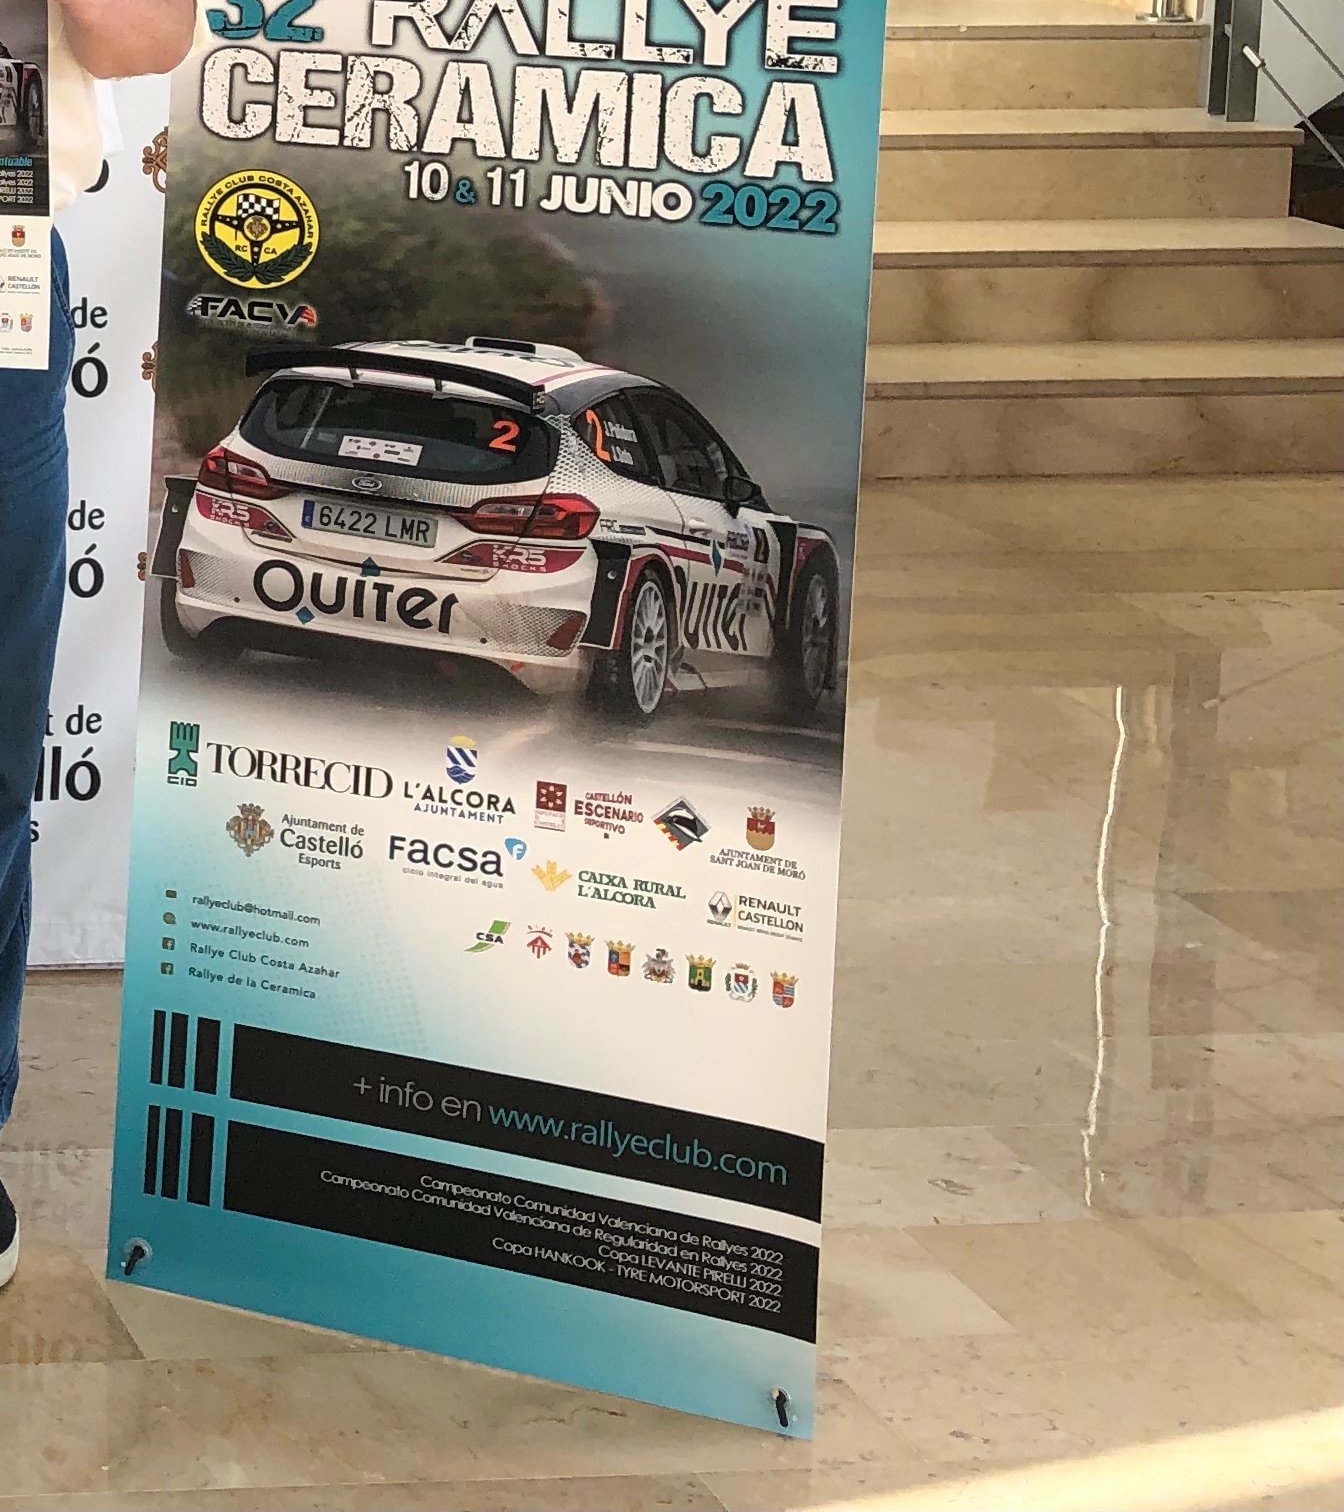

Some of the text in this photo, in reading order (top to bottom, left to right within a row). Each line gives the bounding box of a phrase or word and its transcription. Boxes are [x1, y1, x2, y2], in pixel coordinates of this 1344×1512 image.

[201, 47, 835, 183] CERAMICA
[200, 174, 315, 240] RALLYE CLUB COSTA AZAHAR
[403, 159, 838, 236] 10 & 11 JUNIO 2022
[488, 421, 519, 453] 2
[318, 504, 432, 545] 6422 LMR
[206, 742, 393, 799] TORRECID
[574, 799, 644, 826] ESCENARIO
[280, 827, 364, 860] Castelló
[578, 868, 686, 900] CAIXA RURAL
[379, 1075, 789, 1185] info en www.rallyeclub.com
